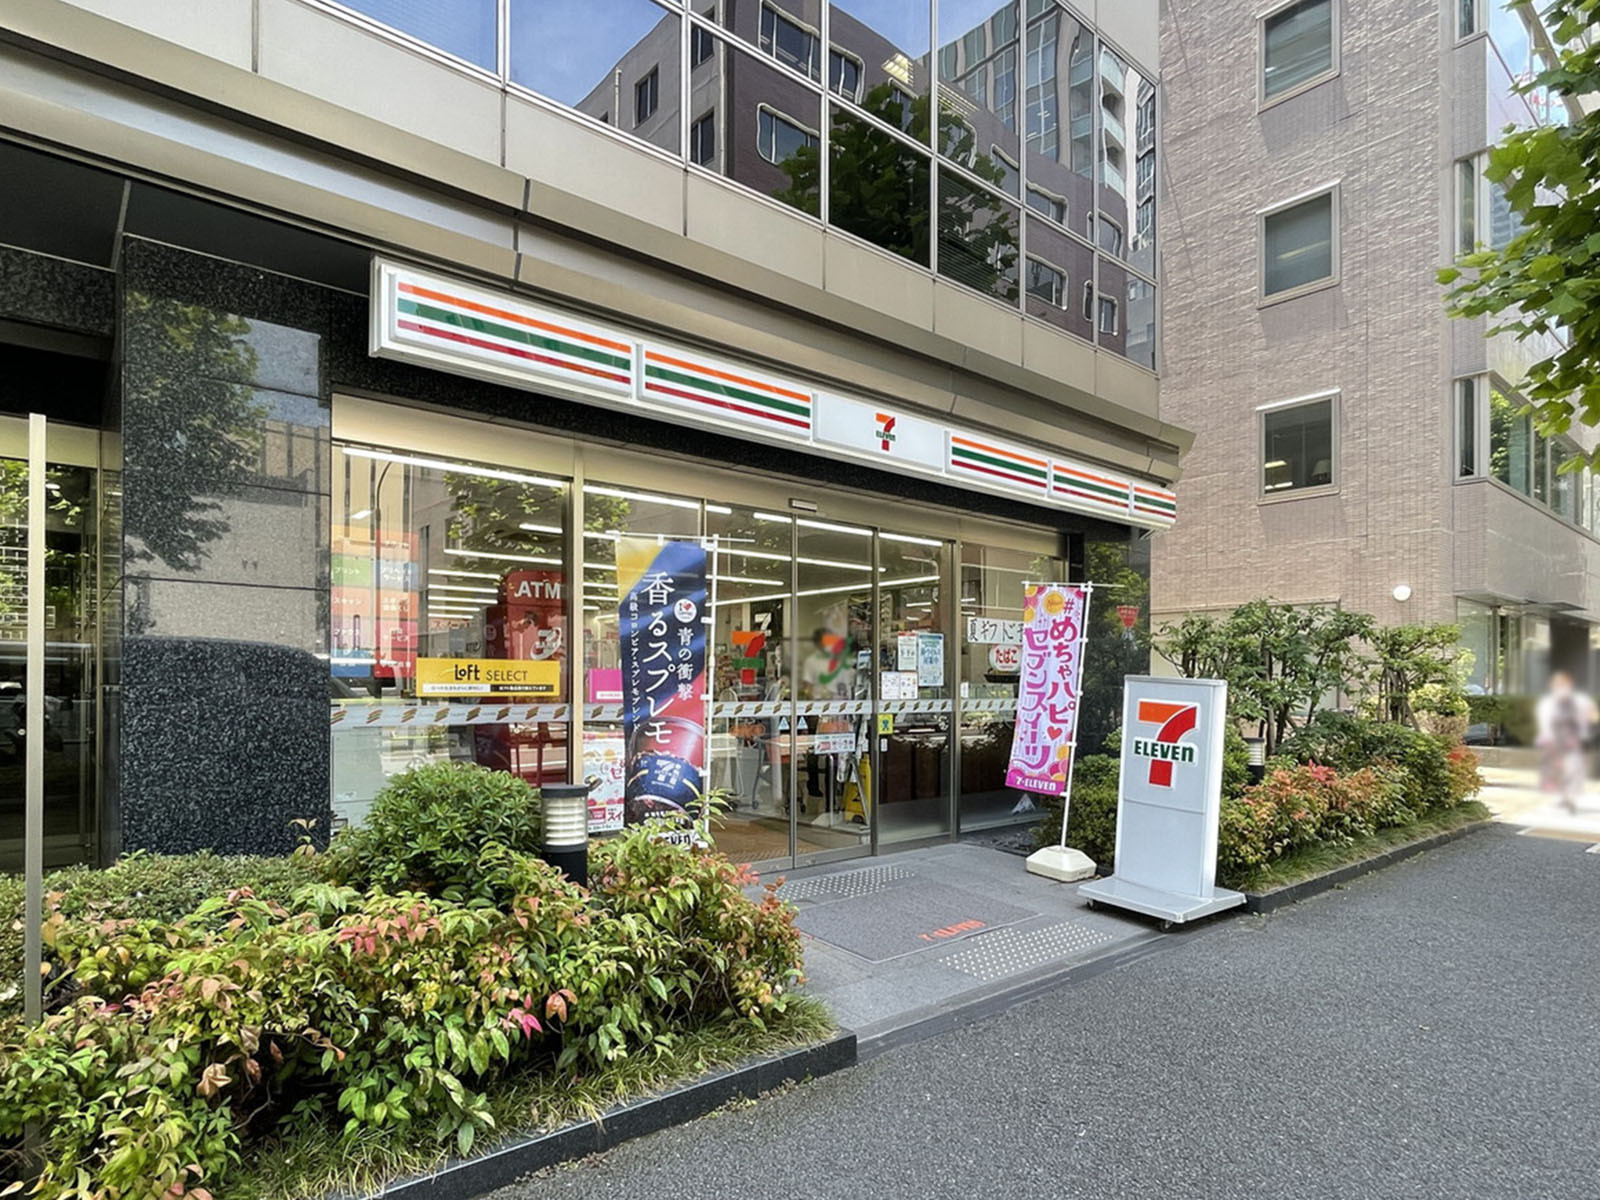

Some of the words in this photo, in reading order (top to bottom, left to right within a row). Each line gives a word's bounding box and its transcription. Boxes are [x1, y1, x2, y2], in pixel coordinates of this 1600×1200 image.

[875, 412, 895, 451] 7
[515, 580, 561, 600] ATM
[640, 571, 676, 744] 香るスプレモ
[676, 627, 694, 702] 青の衝撃
[996, 648, 1018, 664] たばこ
[486, 670, 529, 682] SELECT
[1138, 701, 1197, 787] 7
